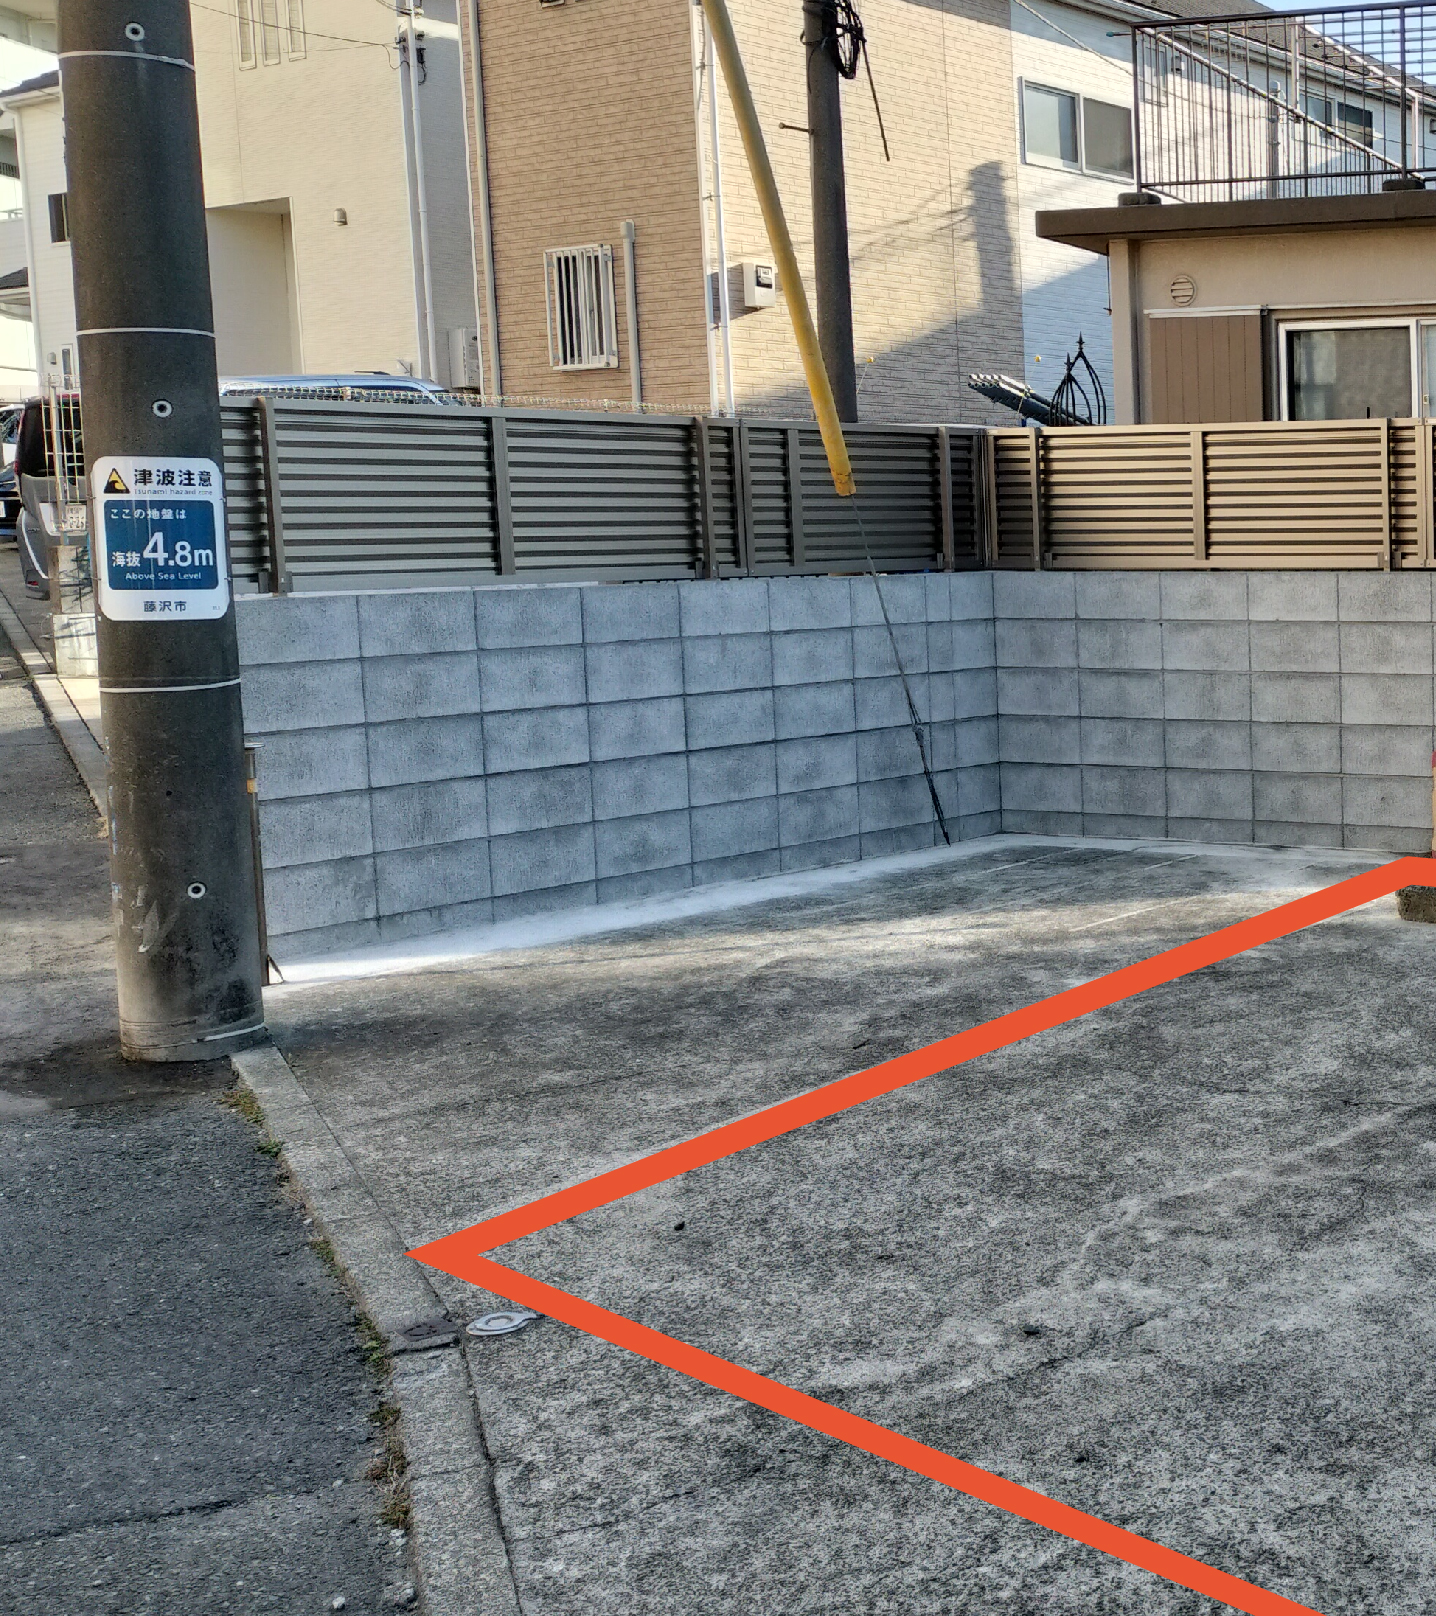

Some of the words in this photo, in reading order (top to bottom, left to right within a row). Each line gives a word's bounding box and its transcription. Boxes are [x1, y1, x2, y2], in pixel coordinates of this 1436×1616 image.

[134, 468, 212, 487] 津波注意
[110, 508, 187, 520] ここの地盤は
[112, 551, 141, 567] 海抜
[142, 531, 214, 567] 4.8m
[125, 572, 155, 580] Above
[157, 572, 175, 580] Sea
[178, 572, 202, 580] Level
[143, 600, 187, 613] 藤沢市
